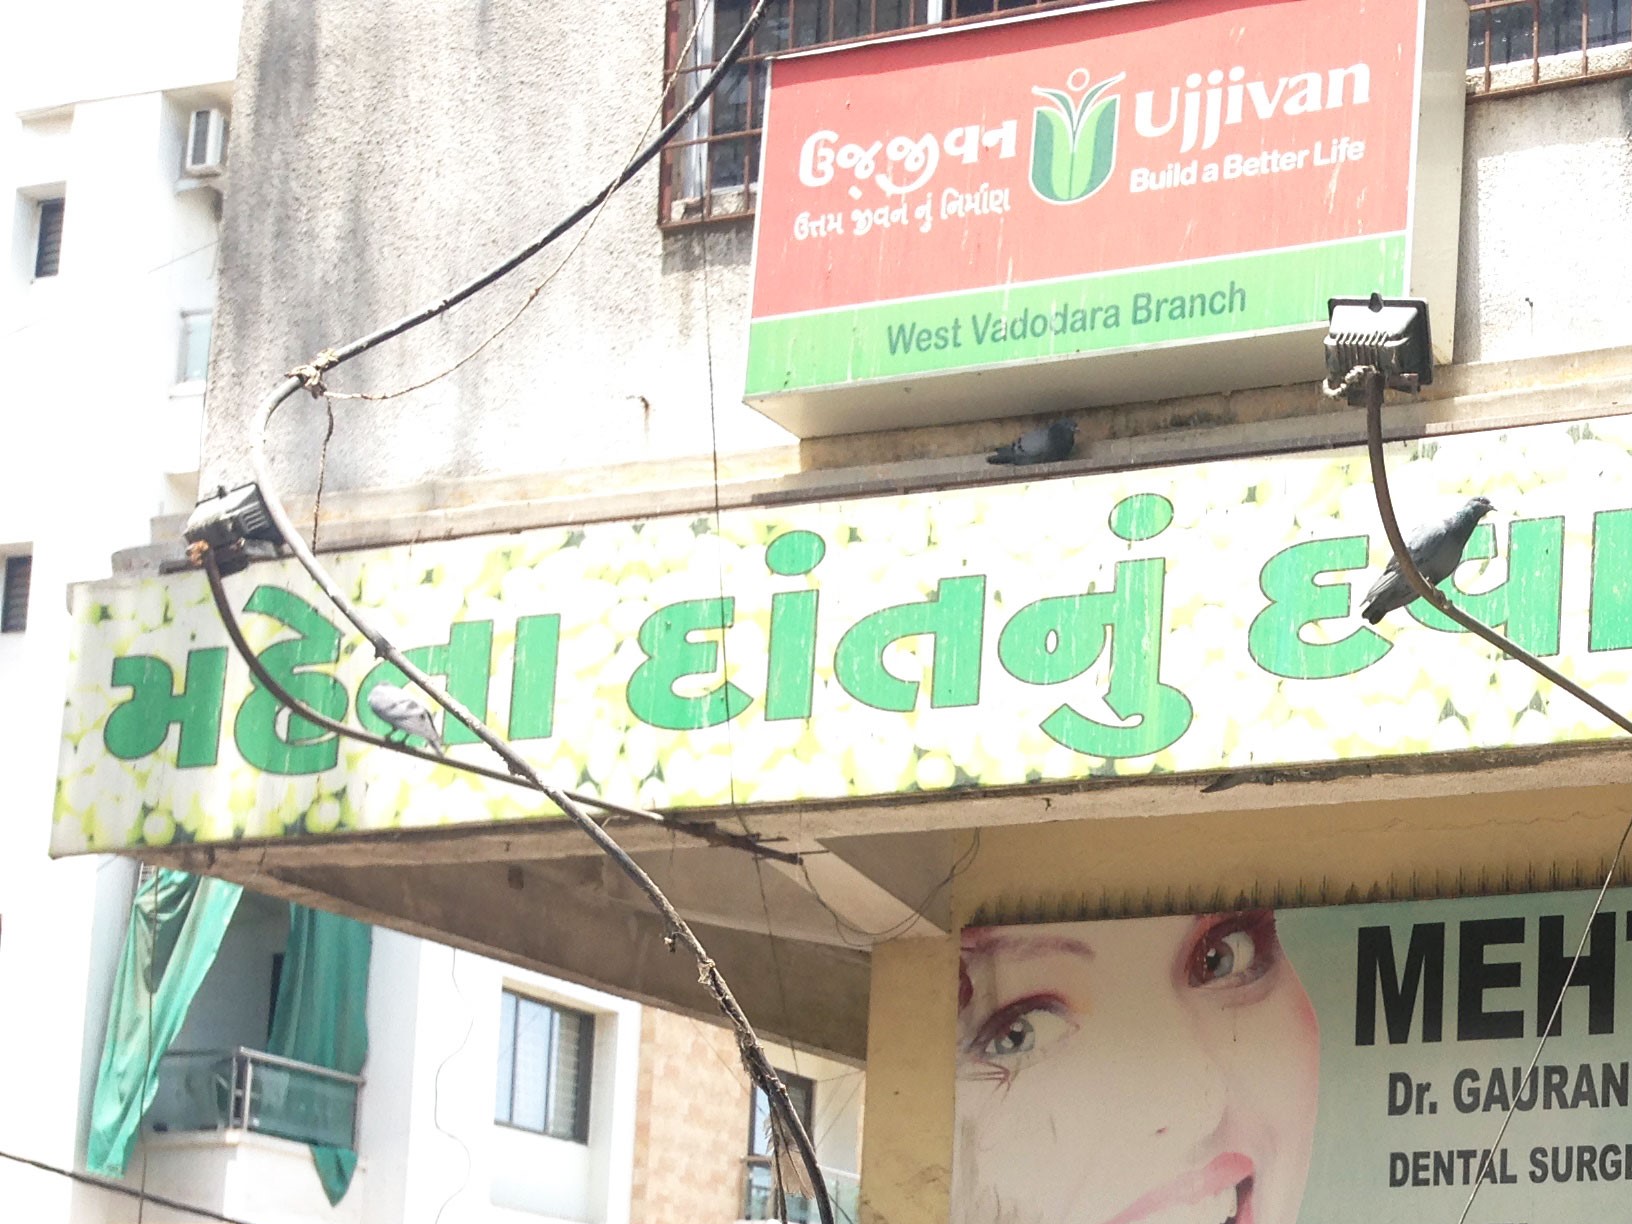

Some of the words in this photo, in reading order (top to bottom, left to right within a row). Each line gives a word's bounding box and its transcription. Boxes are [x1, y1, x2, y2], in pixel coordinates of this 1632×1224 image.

[1135, 62, 1371, 154] Ujjivan
[1130, 160, 1199, 193] Build
[1202, 163, 1219, 183] a
[1223, 149, 1310, 181] Better
[1313, 136, 1365, 167] Life
[886, 321, 962, 357] West
[971, 303, 1121, 344] Vadodara
[1132, 281, 1247, 325] Branch
[1387, 1072, 1439, 1117] Dr.
[1388, 1148, 1518, 1188] DENTAL
